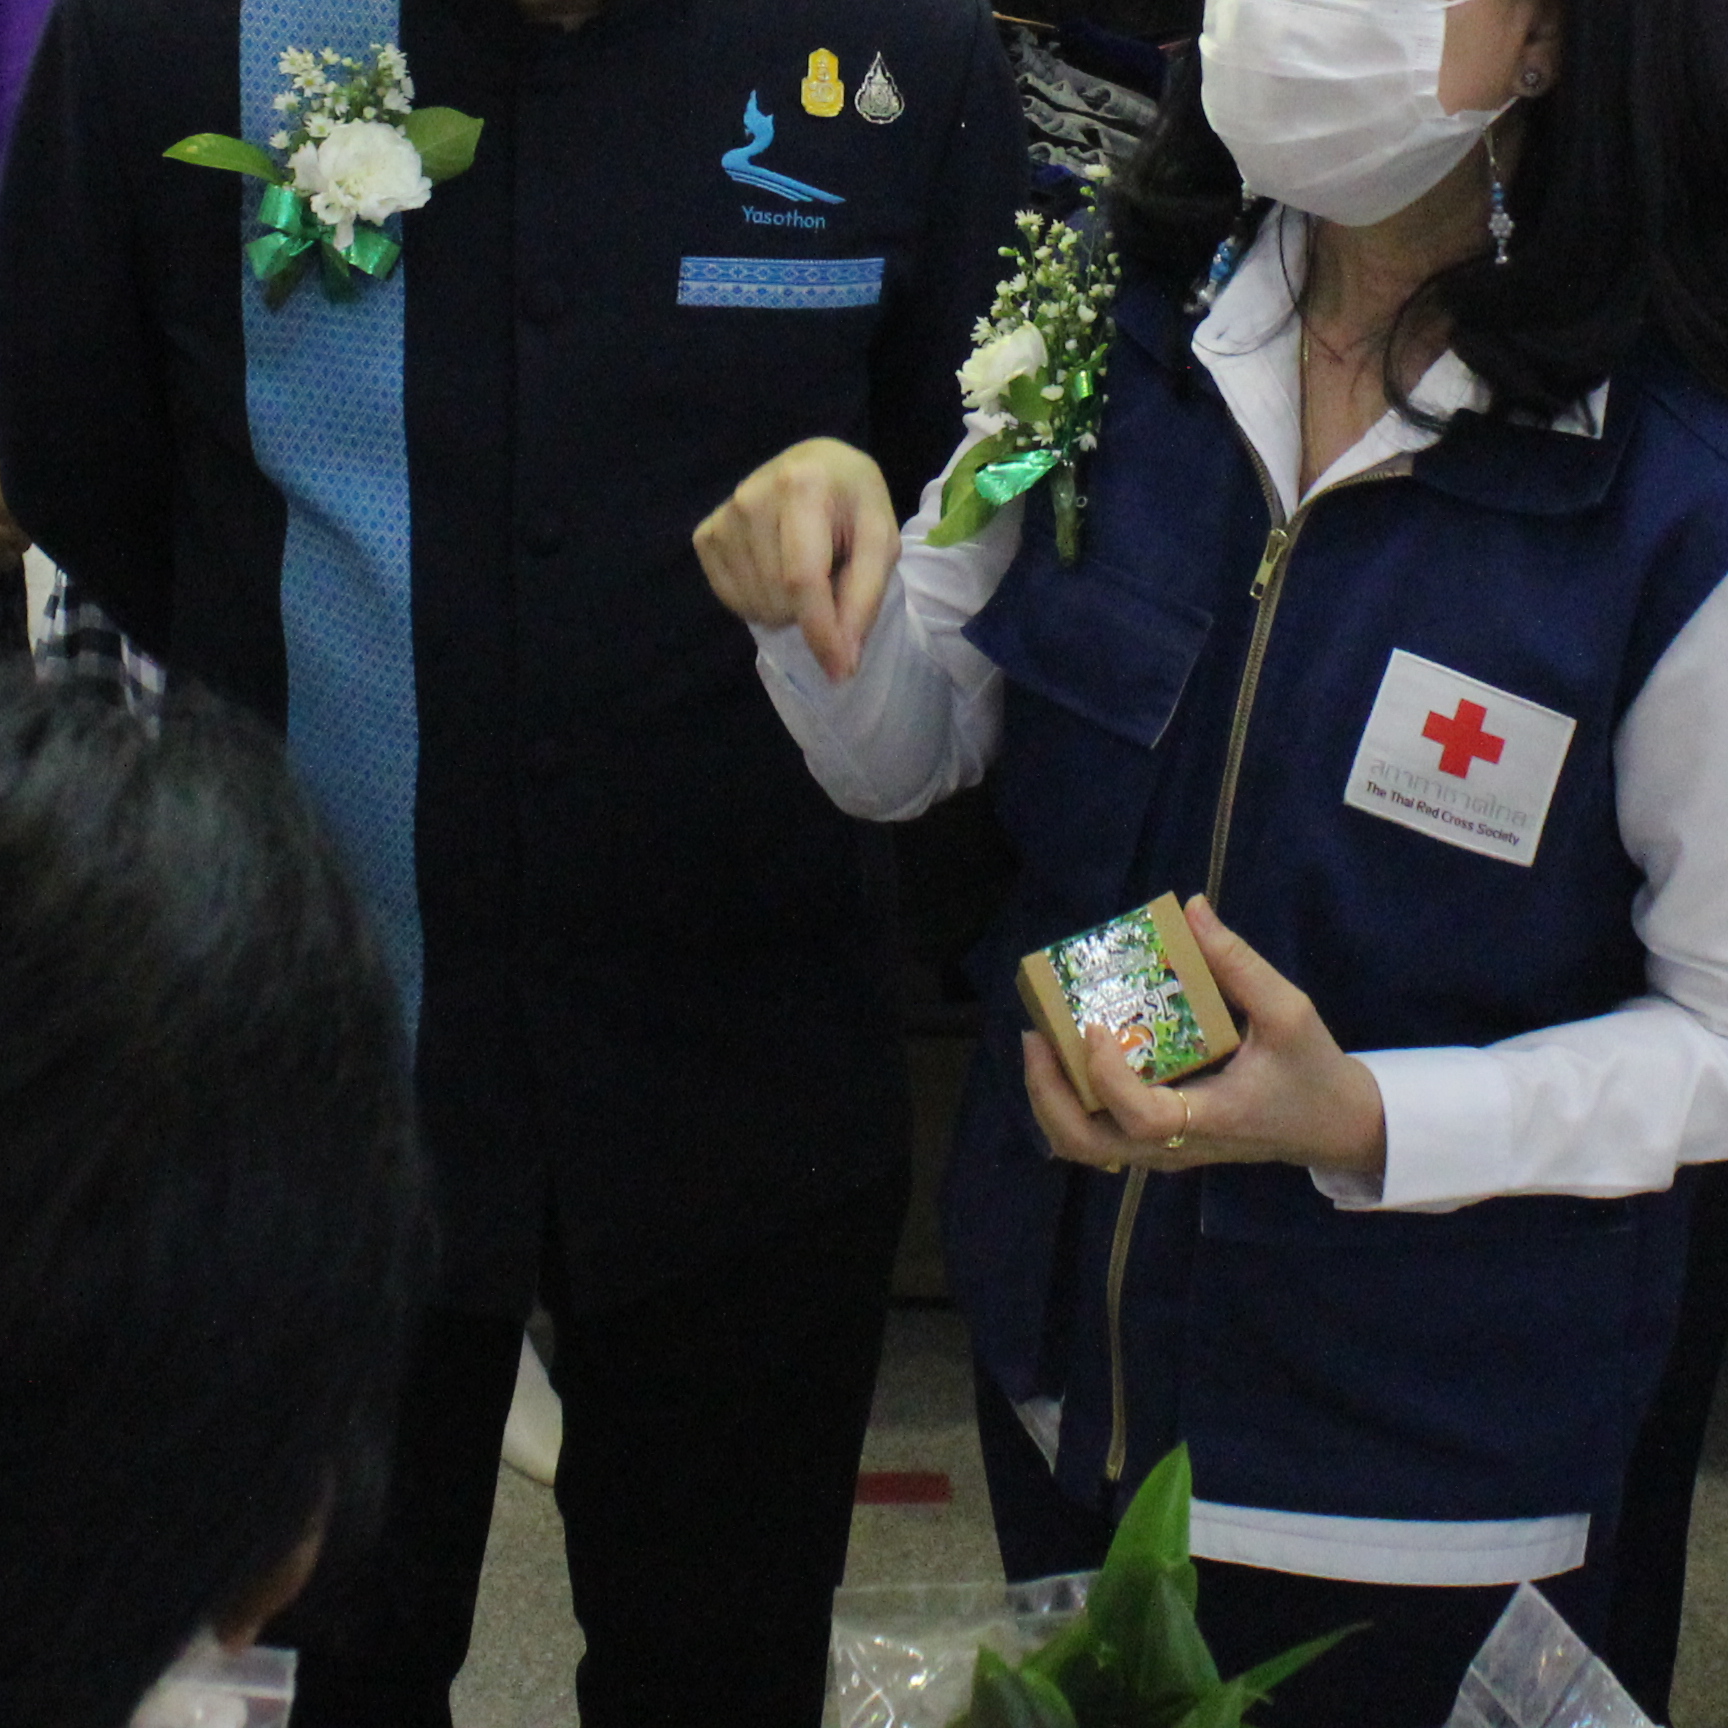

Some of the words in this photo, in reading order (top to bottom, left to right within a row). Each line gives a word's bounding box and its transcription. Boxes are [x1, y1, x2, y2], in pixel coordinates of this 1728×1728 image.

[741, 205, 826, 229] Yasothon
[1366, 780, 1387, 798] The
[1390, 790, 1414, 808] Thai
[1416, 800, 1440, 819] Red
[1441, 810, 1474, 831] Cross
[1476, 823, 1520, 846] Society
